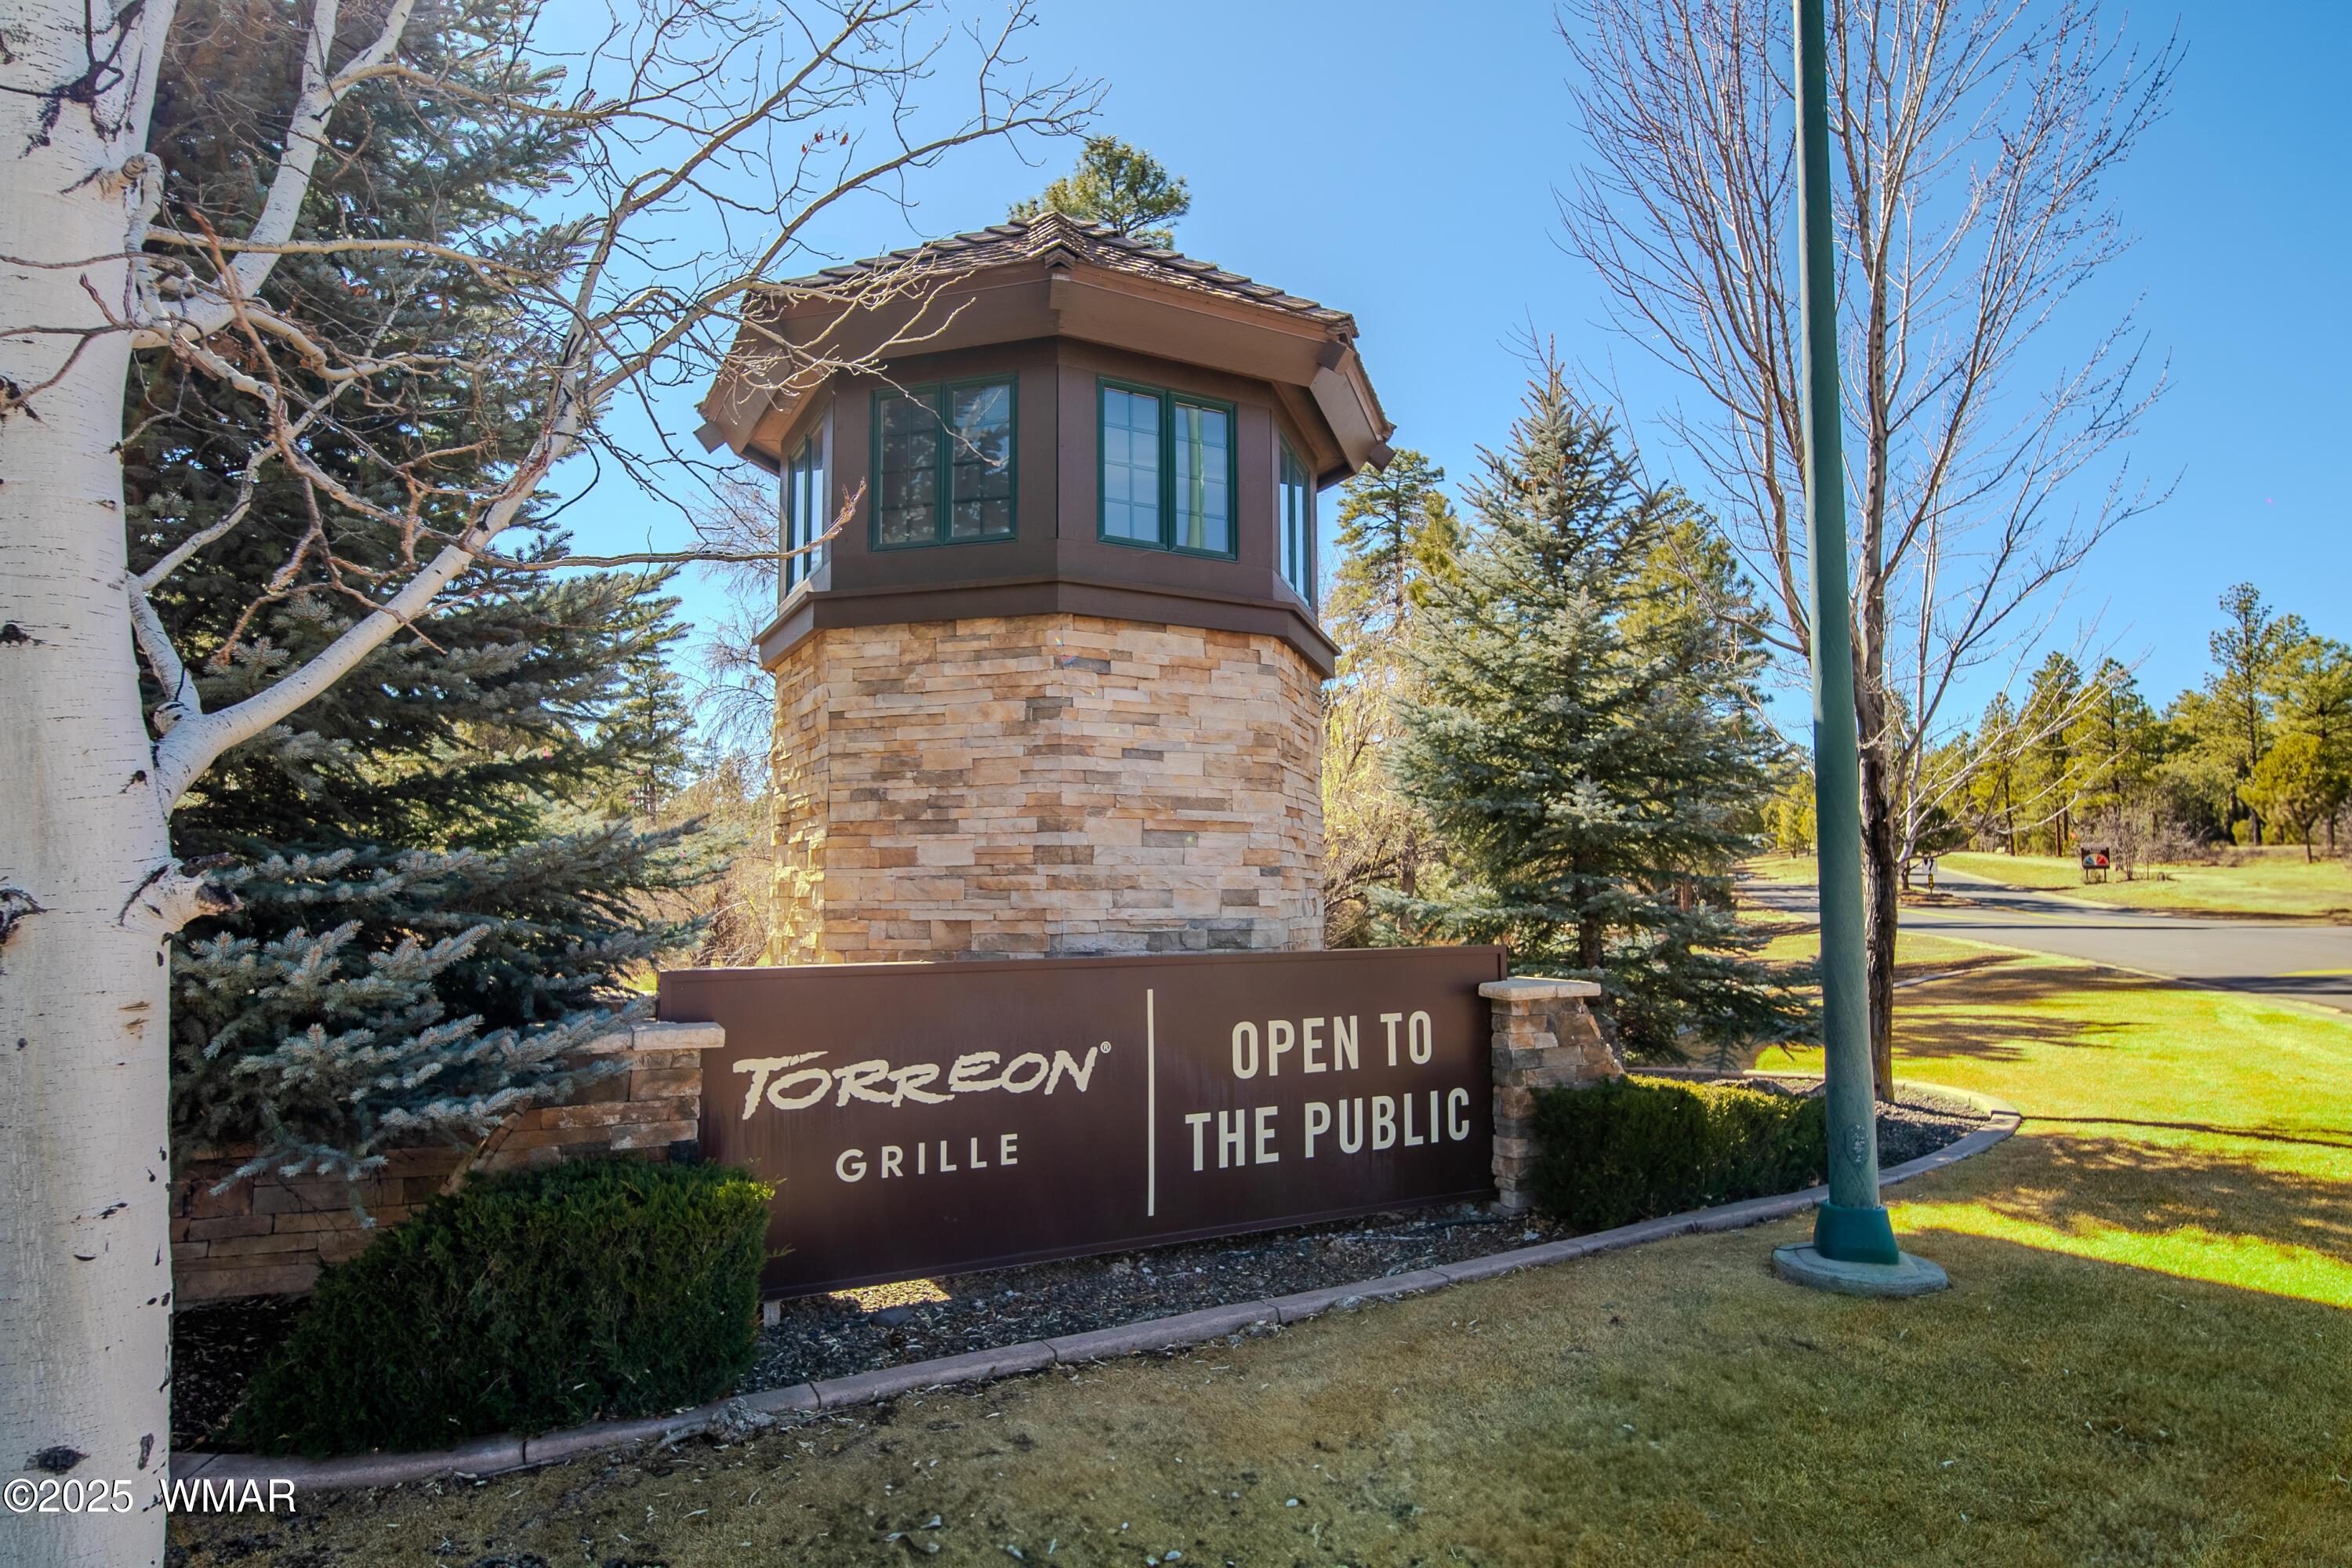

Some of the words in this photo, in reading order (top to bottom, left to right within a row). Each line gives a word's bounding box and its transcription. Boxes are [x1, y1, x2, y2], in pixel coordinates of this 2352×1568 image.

[1232, 1014, 1359, 1080] OPEN
[1380, 1011, 1432, 1067] TO
[836, 1134, 1018, 1183] GRILLE
[1185, 1105, 1279, 1172] THE
[1305, 1087, 1470, 1159] PUBLIC
